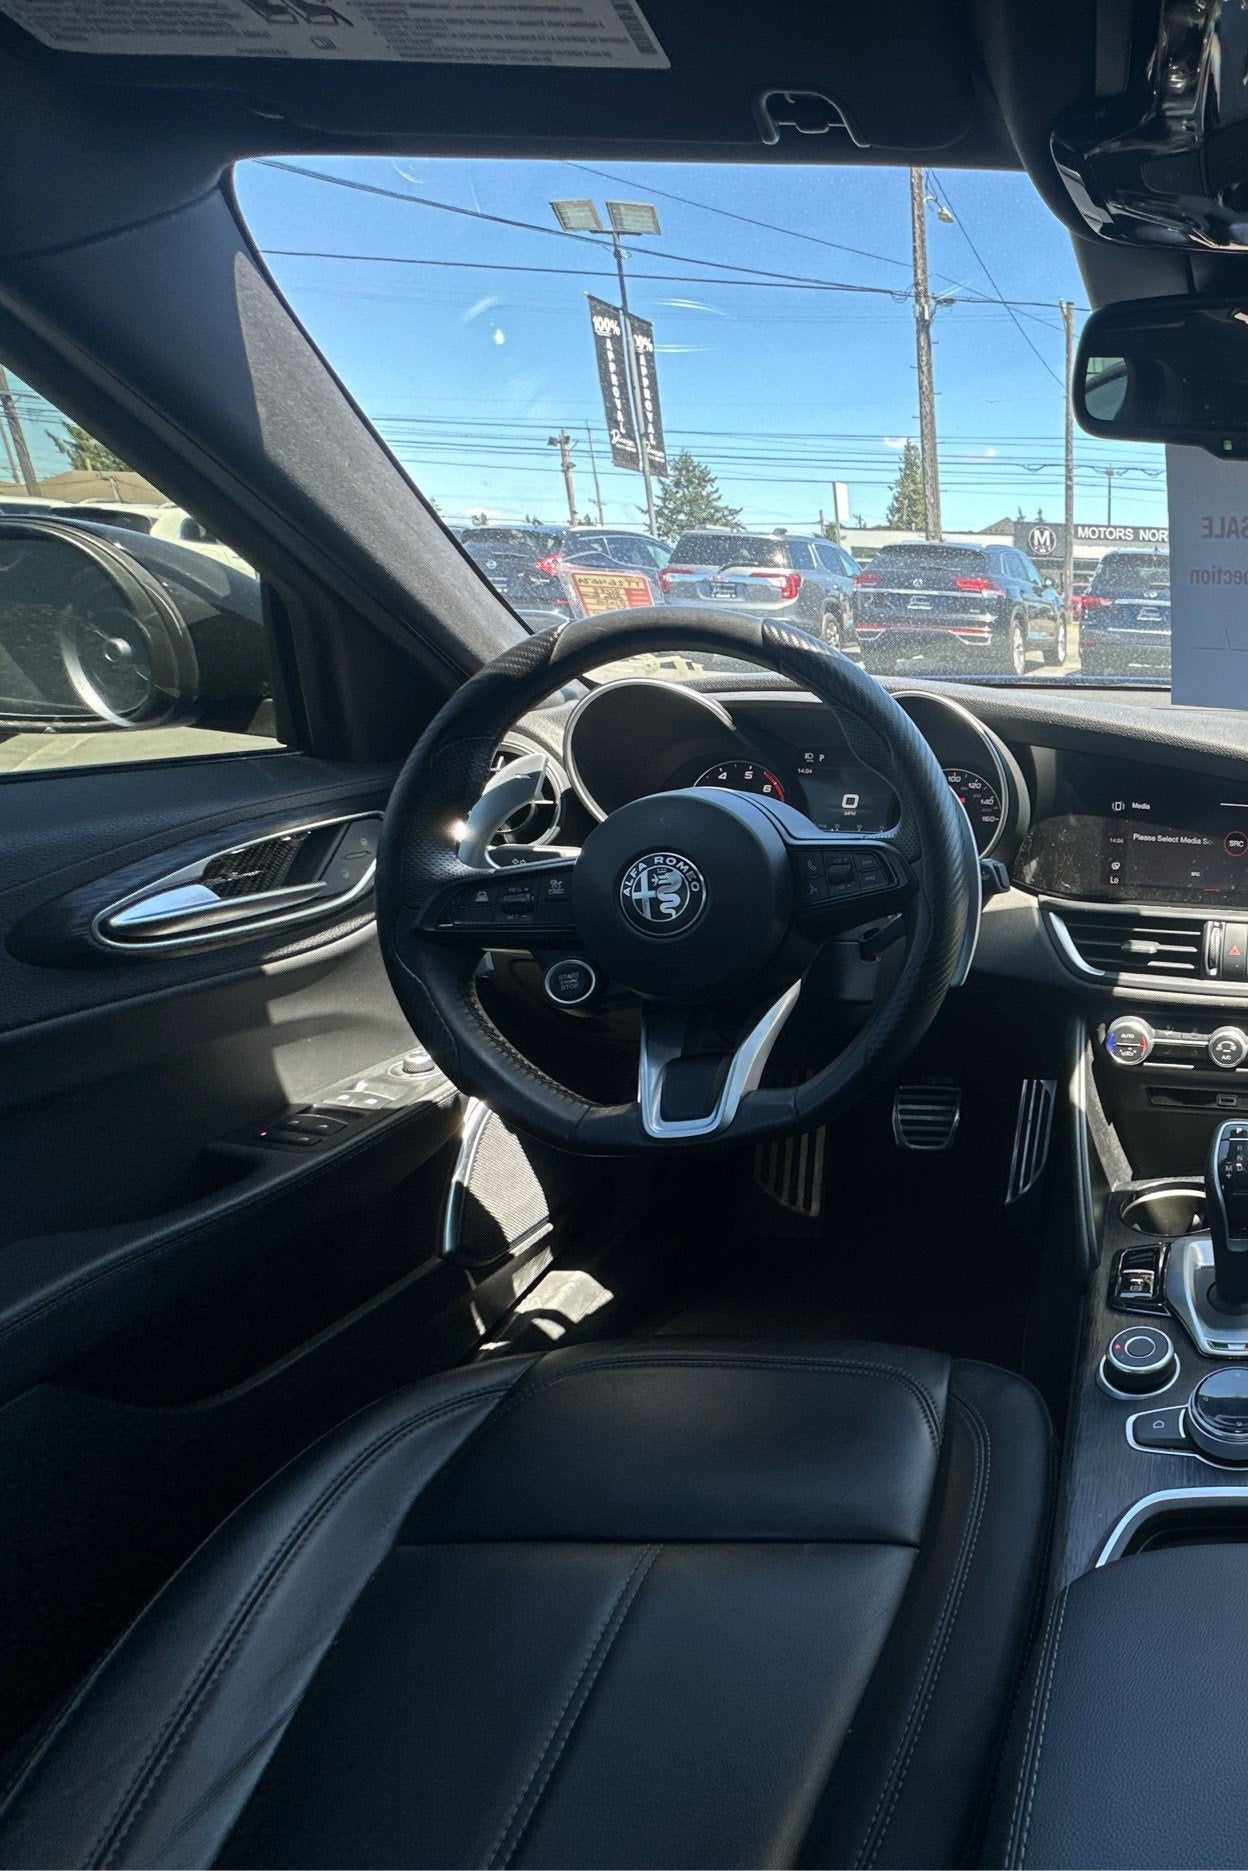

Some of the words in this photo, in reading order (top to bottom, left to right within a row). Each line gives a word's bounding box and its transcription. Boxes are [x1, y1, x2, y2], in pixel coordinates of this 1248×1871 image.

[592, 315, 620, 336] 100%
[1033, 529, 1051, 546] M
[1078, 526, 1134, 541] MOTORS
[1139, 529, 1169, 542] NOR
[718, 772, 728, 780] 4
[744, 771, 753, 780] 5
[762, 784, 772, 793] 6
[842, 794, 860, 809] 0
[1132, 802, 1150, 810] Media
[1133, 833, 1156, 842] Please
[1157, 834, 1179, 844] Select
[1180, 836, 1201, 845] Media
[1228, 840, 1244, 848] SRC
[623, 862, 647, 897] ALFA
[654, 856, 700, 892] ROMEO
[1110, 876, 1119, 884] Lo
